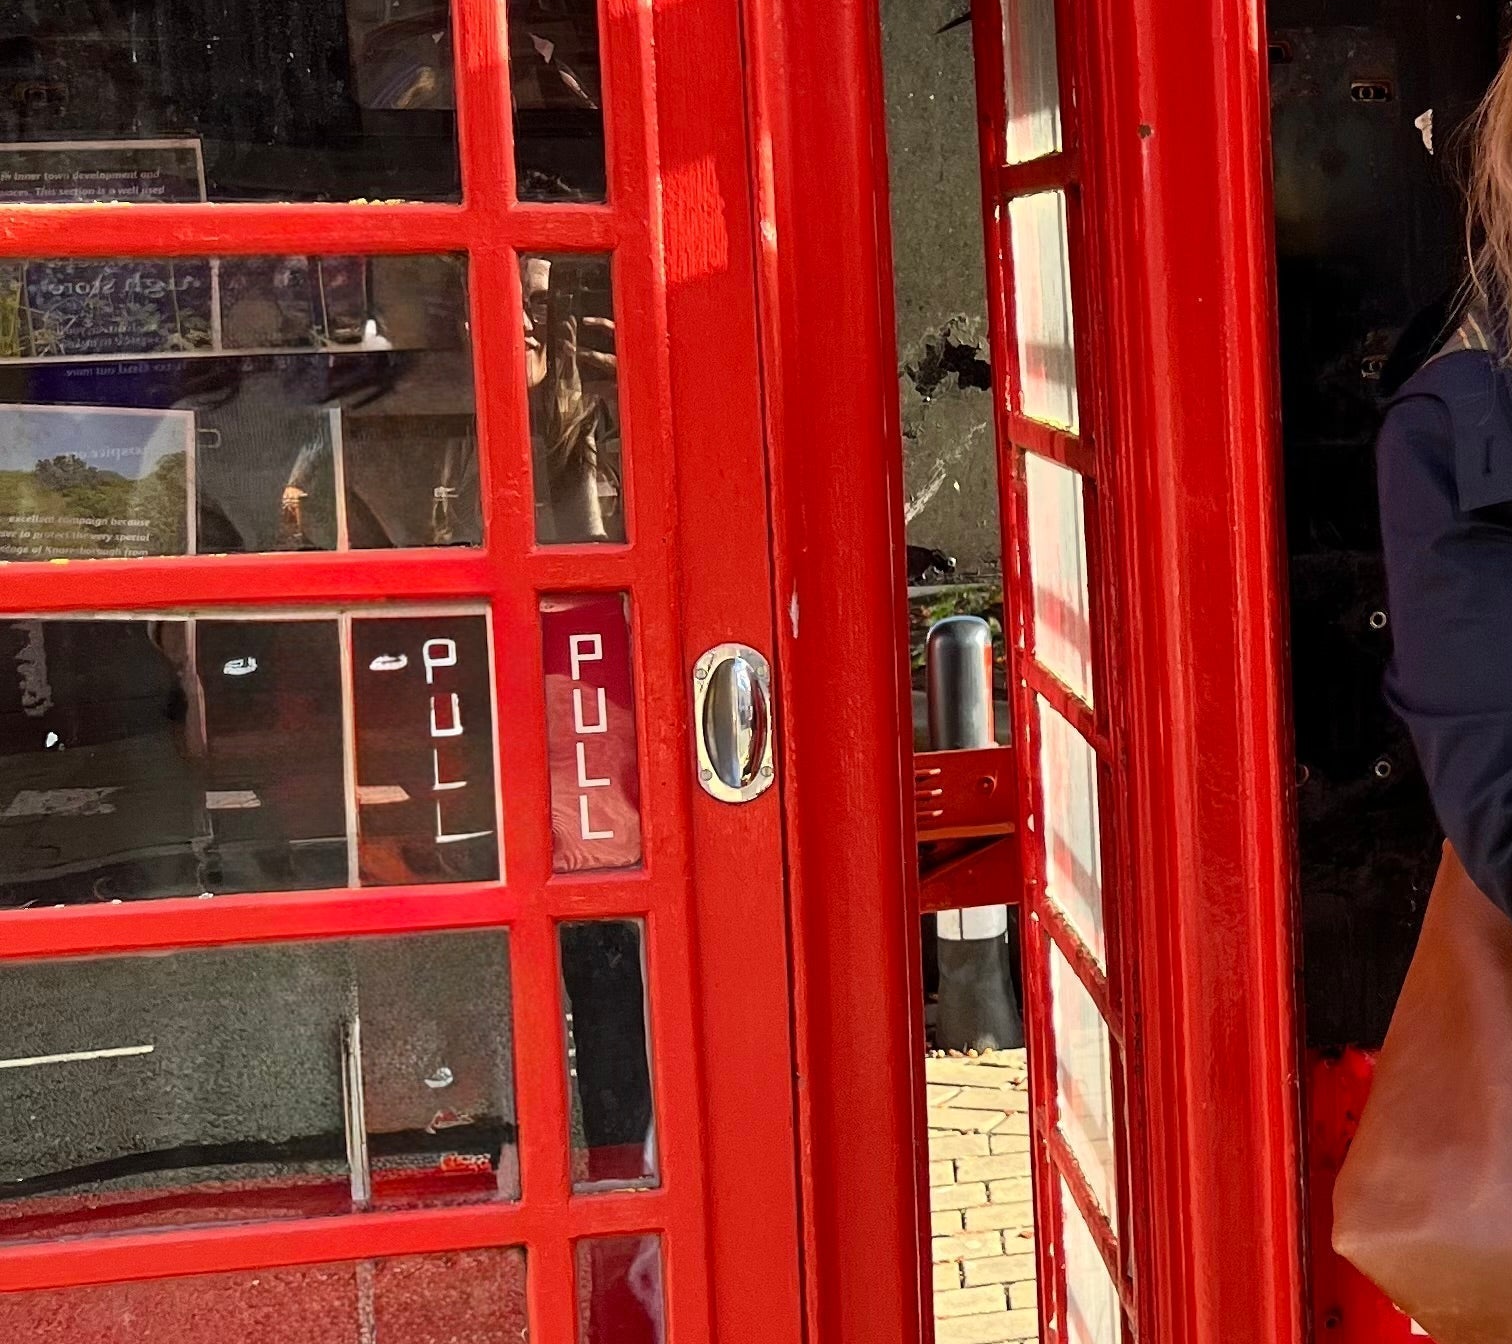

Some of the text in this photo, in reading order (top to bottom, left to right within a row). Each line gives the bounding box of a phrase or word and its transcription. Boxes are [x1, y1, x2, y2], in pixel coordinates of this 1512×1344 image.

[73, 170, 137, 181] development
[140, 167, 160, 179] and
[8, 514, 150, 527] excellent campaign because
[114, 532, 150, 544] special
[124, 546, 150, 558] from
[422, 637, 494, 844] PULL
[569, 633, 614, 841] PULL
